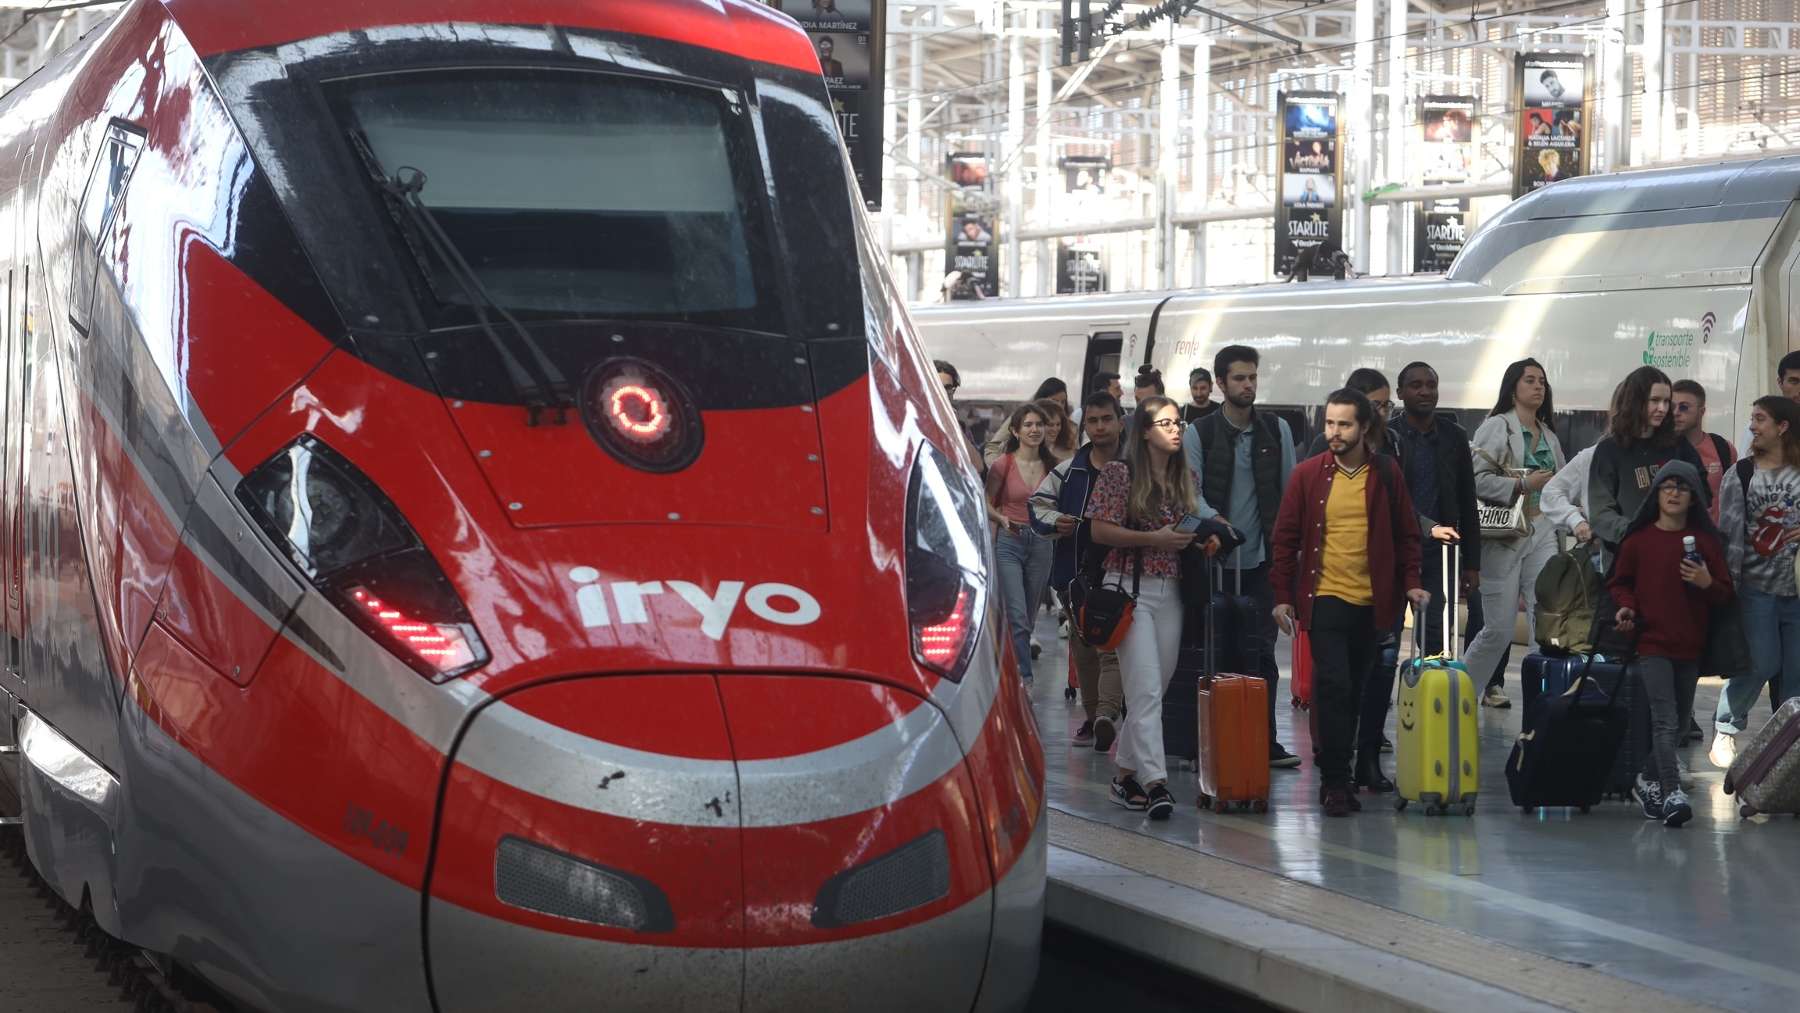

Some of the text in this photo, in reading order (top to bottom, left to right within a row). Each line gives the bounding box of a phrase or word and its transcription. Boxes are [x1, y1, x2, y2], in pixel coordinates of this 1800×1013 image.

[819, 20, 857, 30] MARTÍNEZ
[1288, 220, 1329, 237] STARLITE
[1426, 224, 1466, 241] STARLITE
[1175, 335, 1200, 360] renfe
[1655, 331, 1694, 347] transporte
[1653, 351, 1691, 368] sostenible
[1766, 480, 1793, 493] THE
[568, 565, 822, 641] iryo
